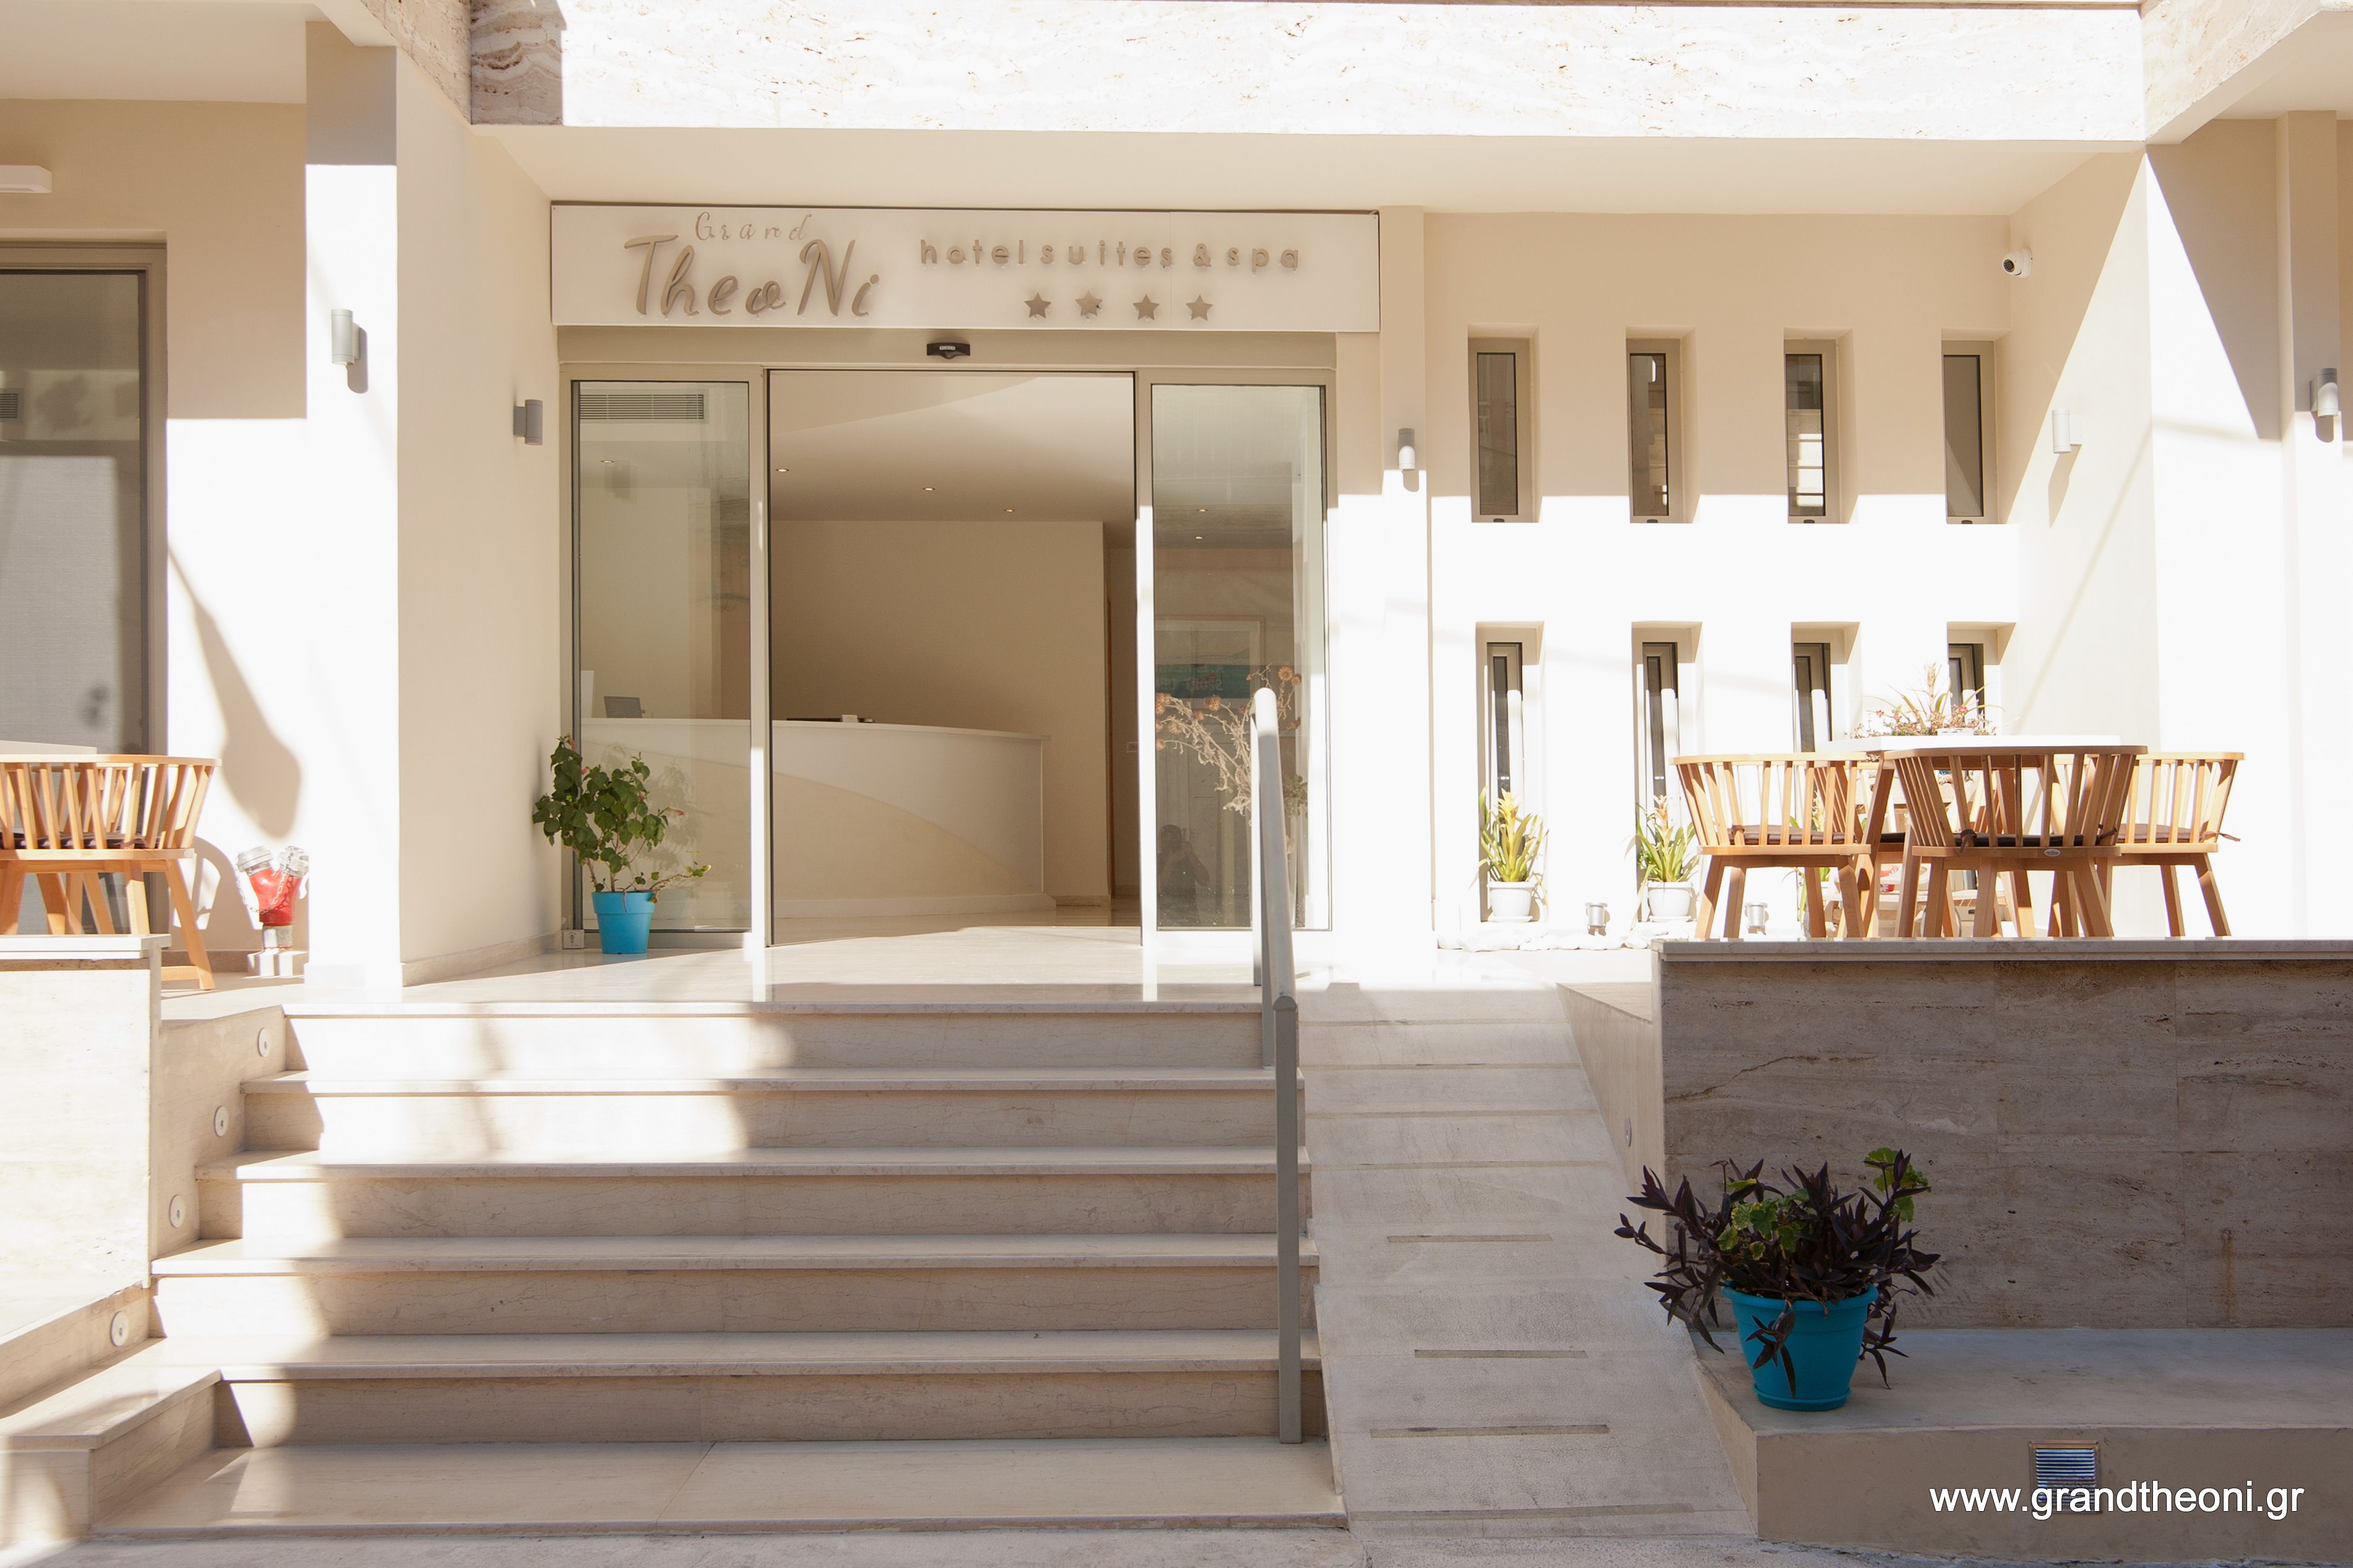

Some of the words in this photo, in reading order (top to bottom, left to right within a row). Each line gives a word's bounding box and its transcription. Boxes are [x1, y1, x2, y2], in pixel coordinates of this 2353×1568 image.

[695, 211, 812, 241] Grand
[920, 239, 1024, 265] hotel
[1040, 240, 1173, 267] suites
[1193, 243, 1212, 267] &
[1227, 246, 1298, 273] spa
